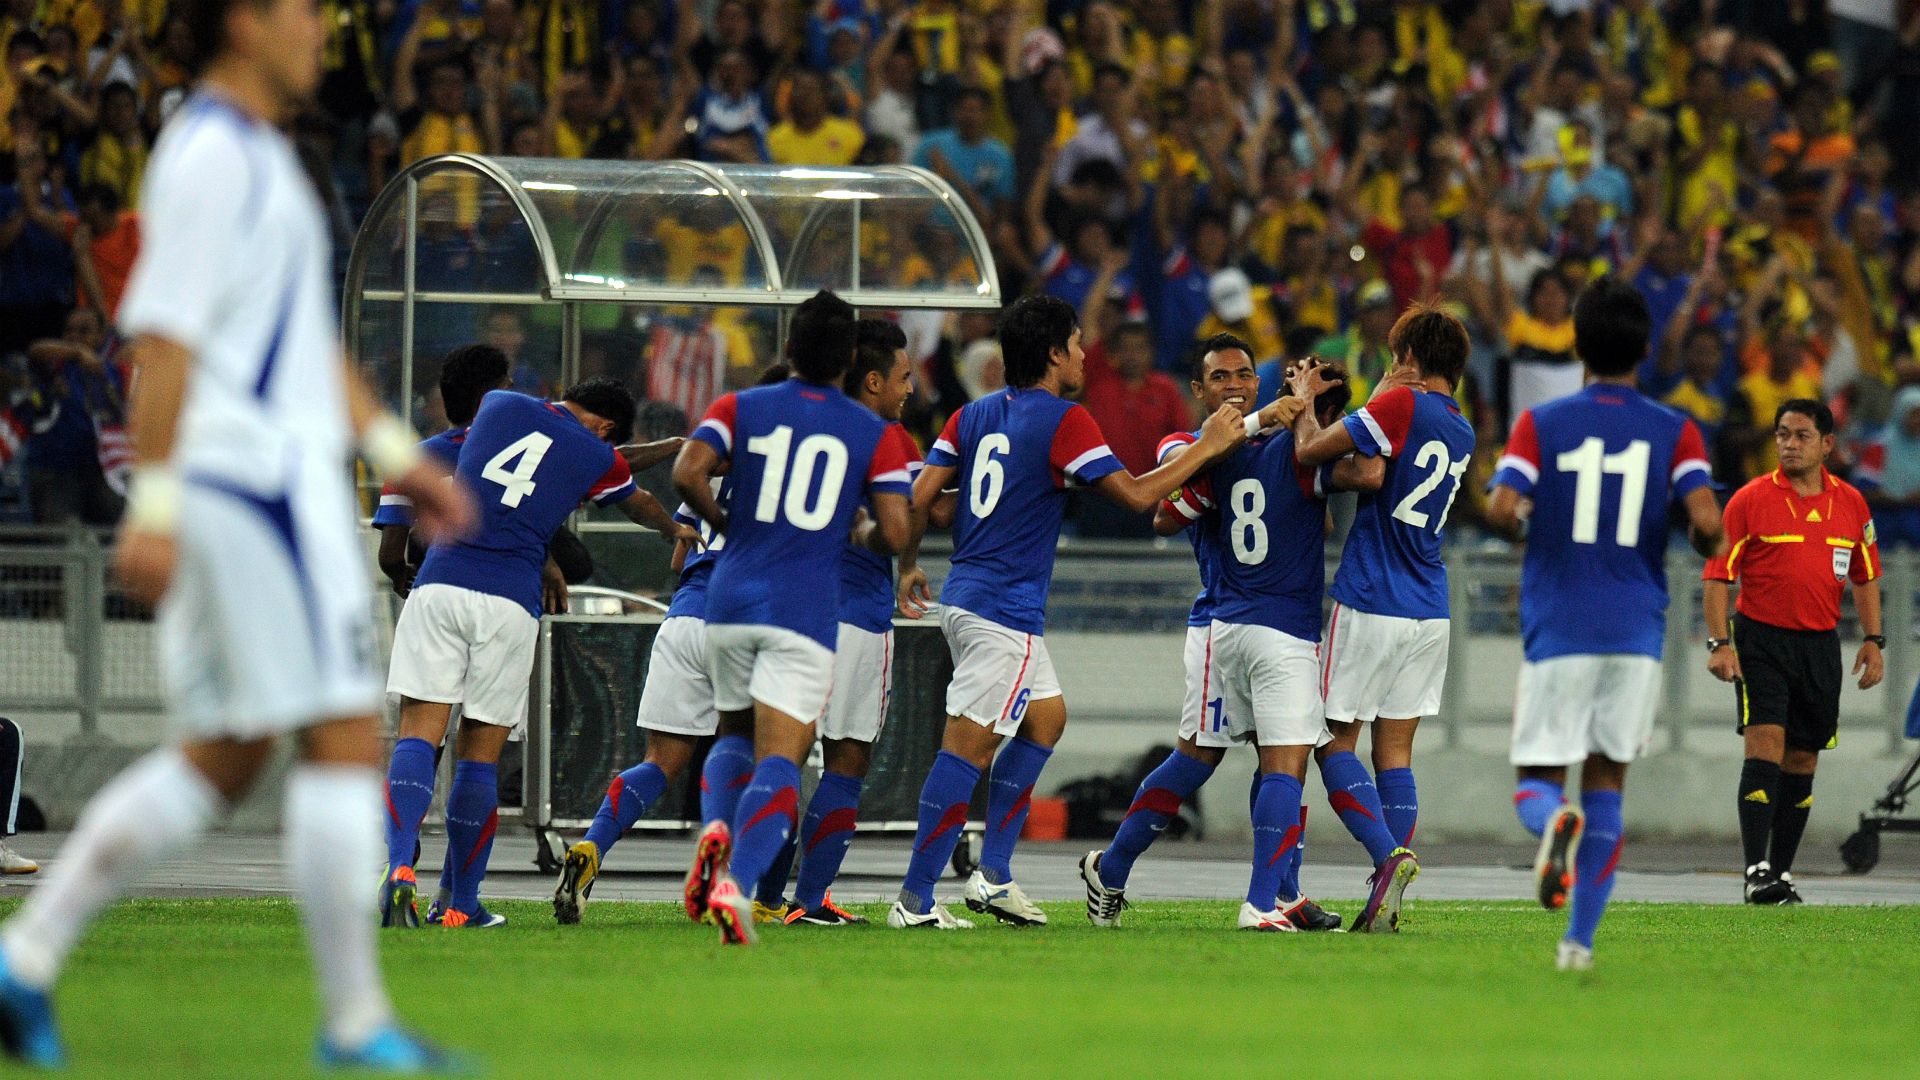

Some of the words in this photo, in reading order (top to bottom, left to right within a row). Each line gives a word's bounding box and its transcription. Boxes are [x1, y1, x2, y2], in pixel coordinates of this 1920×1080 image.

[481, 431, 554, 509] 4
[747, 425, 849, 531] 10
[969, 433, 1011, 519] 6
[1391, 440, 1472, 536] 21
[1556, 436, 1651, 548] 11
[1230, 478, 1269, 566] 8
[1010, 687, 1031, 721] 6
[1207, 697, 1229, 733] 1
